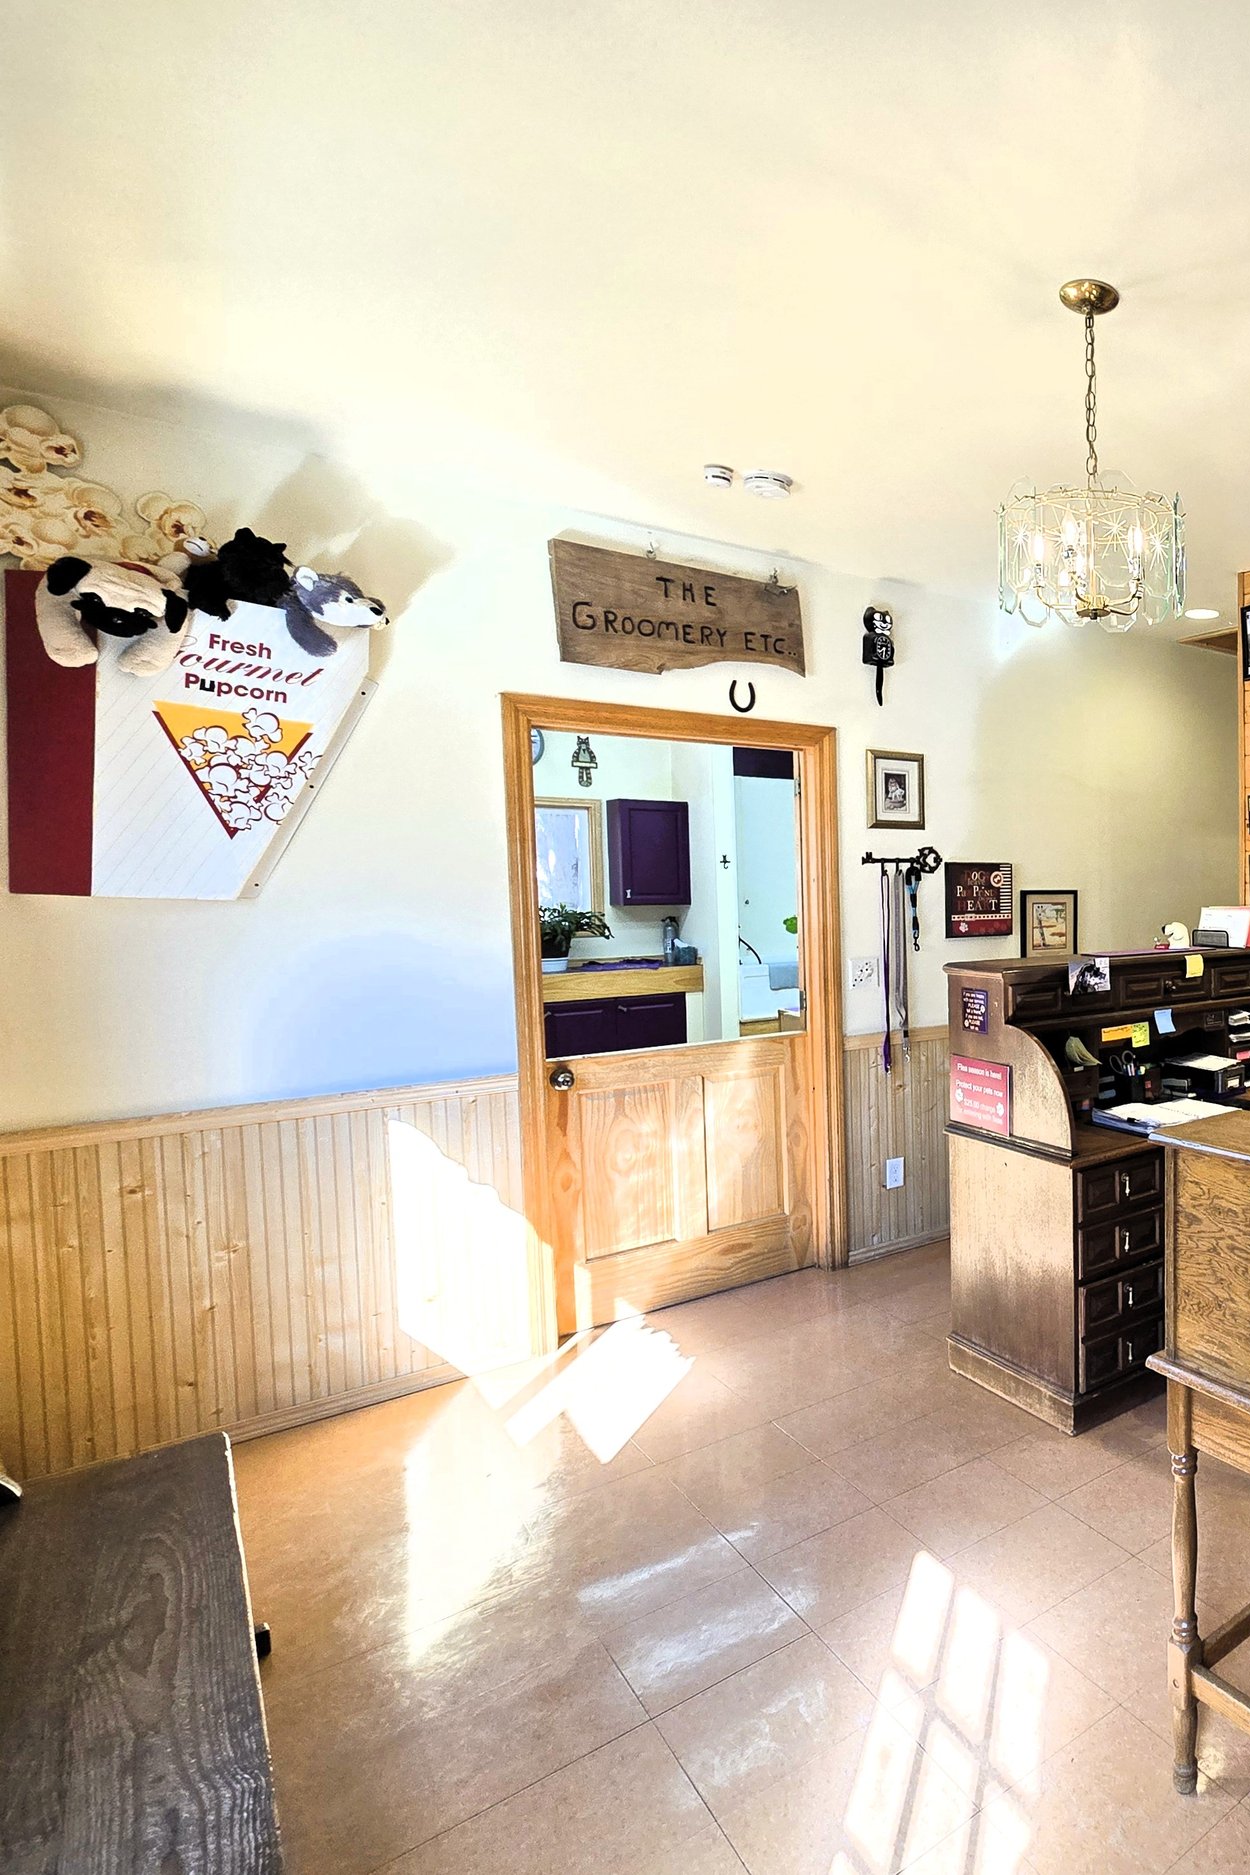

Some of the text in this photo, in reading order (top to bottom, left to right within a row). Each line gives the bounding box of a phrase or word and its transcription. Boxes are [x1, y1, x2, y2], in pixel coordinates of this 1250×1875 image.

[655, 576, 718, 607] THE
[571, 600, 729, 648] GROOMERY
[208, 633, 272, 660] Fresh
[183, 672, 288, 704] Pupcorn
[957, 899, 998, 912] HEART
[957, 1062, 968, 1072] Flea
[968, 1066, 985, 1076] season
[985, 1069, 990, 1077] is
[972, 1084, 983, 1093] your
[994, 1089, 1003, 1097] now
